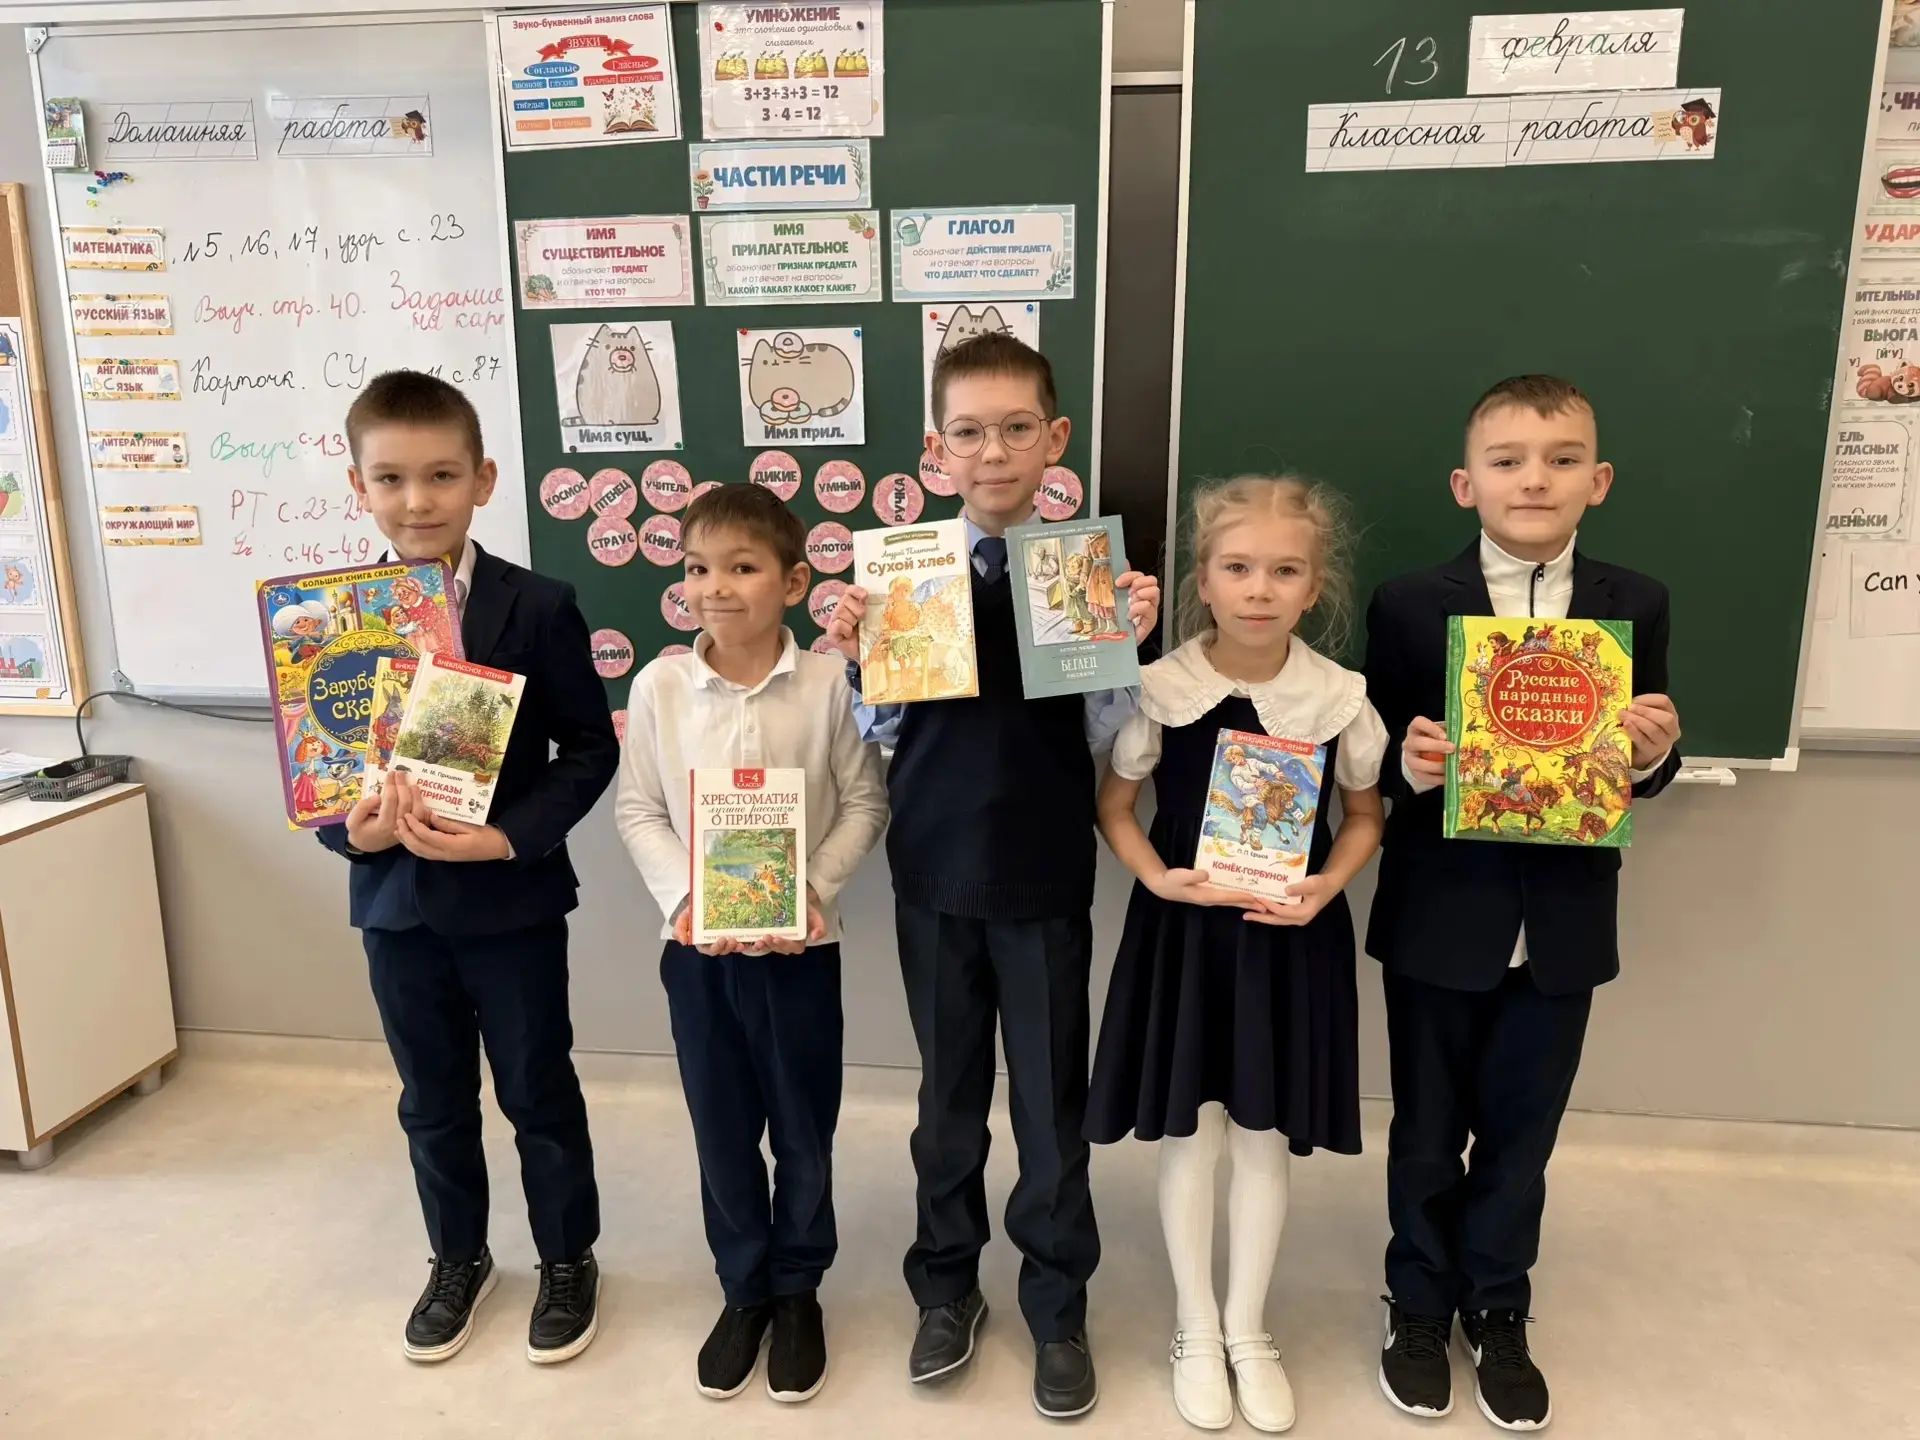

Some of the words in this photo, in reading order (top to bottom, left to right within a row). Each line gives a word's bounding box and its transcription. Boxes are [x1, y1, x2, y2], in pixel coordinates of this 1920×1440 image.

[512, 15, 593, 30] Звуко-буквенный
[595, 15, 627, 24] анализ
[628, 12, 654, 21] слова
[745, 7, 841, 23] УМНОЖЕНИЕ
[754, 24, 797, 34] сложение
[798, 22, 853, 35] одинаковых
[567, 37, 600, 48] ЗВУКИ
[765, 38, 815, 47] слагаемых
[1501, 18, 1658, 75] февраля
[526, 64, 578, 76] Согласные
[612, 59, 650, 70] Гласные
[1373, 36, 1439, 94] 13
[586, 76, 616, 85] УДАРНЫЕ
[620, 74, 661, 83] БЕЗУДАРНЫЕ
[823, 85, 839, 99] 12
[806, 107, 821, 120] 12
[107, 111, 247, 144] Домашняя
[277, 104, 391, 154] работа
[1329, 112, 1485, 147] Классная
[1513, 101, 1653, 157] работа
[713, 166, 787, 188] ЧАСТИ
[790, 164, 846, 186] РЕЧИ
[586, 227, 617, 241] ИМЯ
[774, 222, 805, 236] ИМЯ
[948, 219, 1015, 235] ГЛАГОЛ
[338, 232, 385, 264] узор
[430, 213, 465, 241] 23
[73, 241, 154, 255] МАТЕМАТИКА
[542, 245, 666, 261] СУЩЕСТВИТЕЛЬНОЕ
[731, 241, 849, 257] ПРИЛАГАТЕЛЬНОЕ
[912, 248, 965, 257] обозначает
[966, 244, 1007, 255] ДЕЙСТВИЕ
[1008, 244, 1052, 254] ПРЕДМЕТА
[561, 265, 611, 275] обозначает
[611, 264, 648, 275] ПРЕДМЕТ
[777, 261, 814, 271] ПРИЗНАК
[815, 260, 858, 270] ПРЕДМЕТА
[937, 259, 979, 267] отвечает
[993, 258, 1035, 267] вопросы
[749, 275, 789, 283] отвечает
[803, 273, 844, 283] вопросы
[924, 271, 941, 280] ЧТО
[941, 270, 978, 280] ДЕЛАЕТ?
[980, 269, 996, 278] ЧТО
[997, 268, 1039, 278] СДЕЛАЕТ?
[563, 278, 603, 286] отвечает
[604, 278, 616, 286] на
[617, 277, 656, 287] вопросы
[728, 285, 759, 294] КАКОЙ?
[761, 284, 792, 294] КАКАЯ?
[794, 284, 824, 293] КАКОЕ?
[826, 283, 857, 292] КАКИЕ?
[390, 269, 505, 318] Задание
[584, 288, 605, 297] КТО?
[606, 287, 627, 297] ЧТО?
[75, 306, 129, 321] РУССКИЙ
[133, 307, 166, 320] ЯЗЫК
[1871, 308, 1889, 316] ЗНАК
[1863, 328, 1919, 342] ВЬЮГА
[97, 364, 159, 376] АНГЛИЙСКИЙ
[116, 382, 144, 393] ЯЗЫК
[578, 428, 612, 444] Имя
[614, 430, 653, 444] сущ.
[764, 425, 798, 440] Имя
[801, 427, 845, 440] прил.
[102, 437, 170, 448] ЛИТЕРАТУРНОЕ
[1835, 443, 1900, 456] ГЛАСНЫХ
[121, 453, 156, 463] ЧТЕНИЕ
[753, 470, 798, 484] ДИКИЕ
[645, 480, 689, 494] УЧИТЕЛЬ
[818, 478, 862, 494] УМНЫЙ
[544, 480, 588, 509] КОСМОС
[594, 478, 632, 513] ПТЕНЕЦ
[894, 476, 906, 523] РУЧКА
[231, 489, 268, 528] РТ
[105, 516, 174, 531] ОКРУЖАЮЩИЙ
[176, 519, 195, 530] МИР
[1826, 514, 1889, 529] ДЕНЬКИ
[591, 533, 635, 550] СТРАУС
[644, 532, 685, 552] КНИГА
[807, 540, 854, 554] ЗОЛОТОЙ
[866, 556, 914, 577] Сухой
[917, 551, 956, 569] хлеб
[302, 576, 344, 588] БОЛЬШАЯ
[346, 572, 373, 582] КНИГА
[373, 567, 405, 578] СКАЗОК
[1864, 571, 1909, 592] Can
[437, 659, 482, 675] ВНЕКЛАССНОЕ
[485, 671, 508, 682] ЧТЕНИЕ
[1061, 656, 1099, 672] БЕГЛЕЦ
[1507, 669, 1580, 690] Русские
[1500, 689, 1588, 705] народные
[1501, 705, 1585, 725] сказки
[1236, 734, 1281, 748] ВНЕКЛАССНОЕ
[1285, 743, 1309, 753] ЧТЕНИЕ
[438, 772, 464, 782] Пришвин
[416, 778, 463, 796] РАССКАЗЫ
[420, 789, 464, 806] ПРИРОДЕ
[701, 793, 799, 806] ХРЕСТОМАТИЯ
[748, 803, 795, 819] рассказы
[711, 814, 722, 826] О
[725, 812, 790, 827] ПРИРОДЕ
[1212, 860, 1289, 883] КОНЁК-ГОРБУНОК
